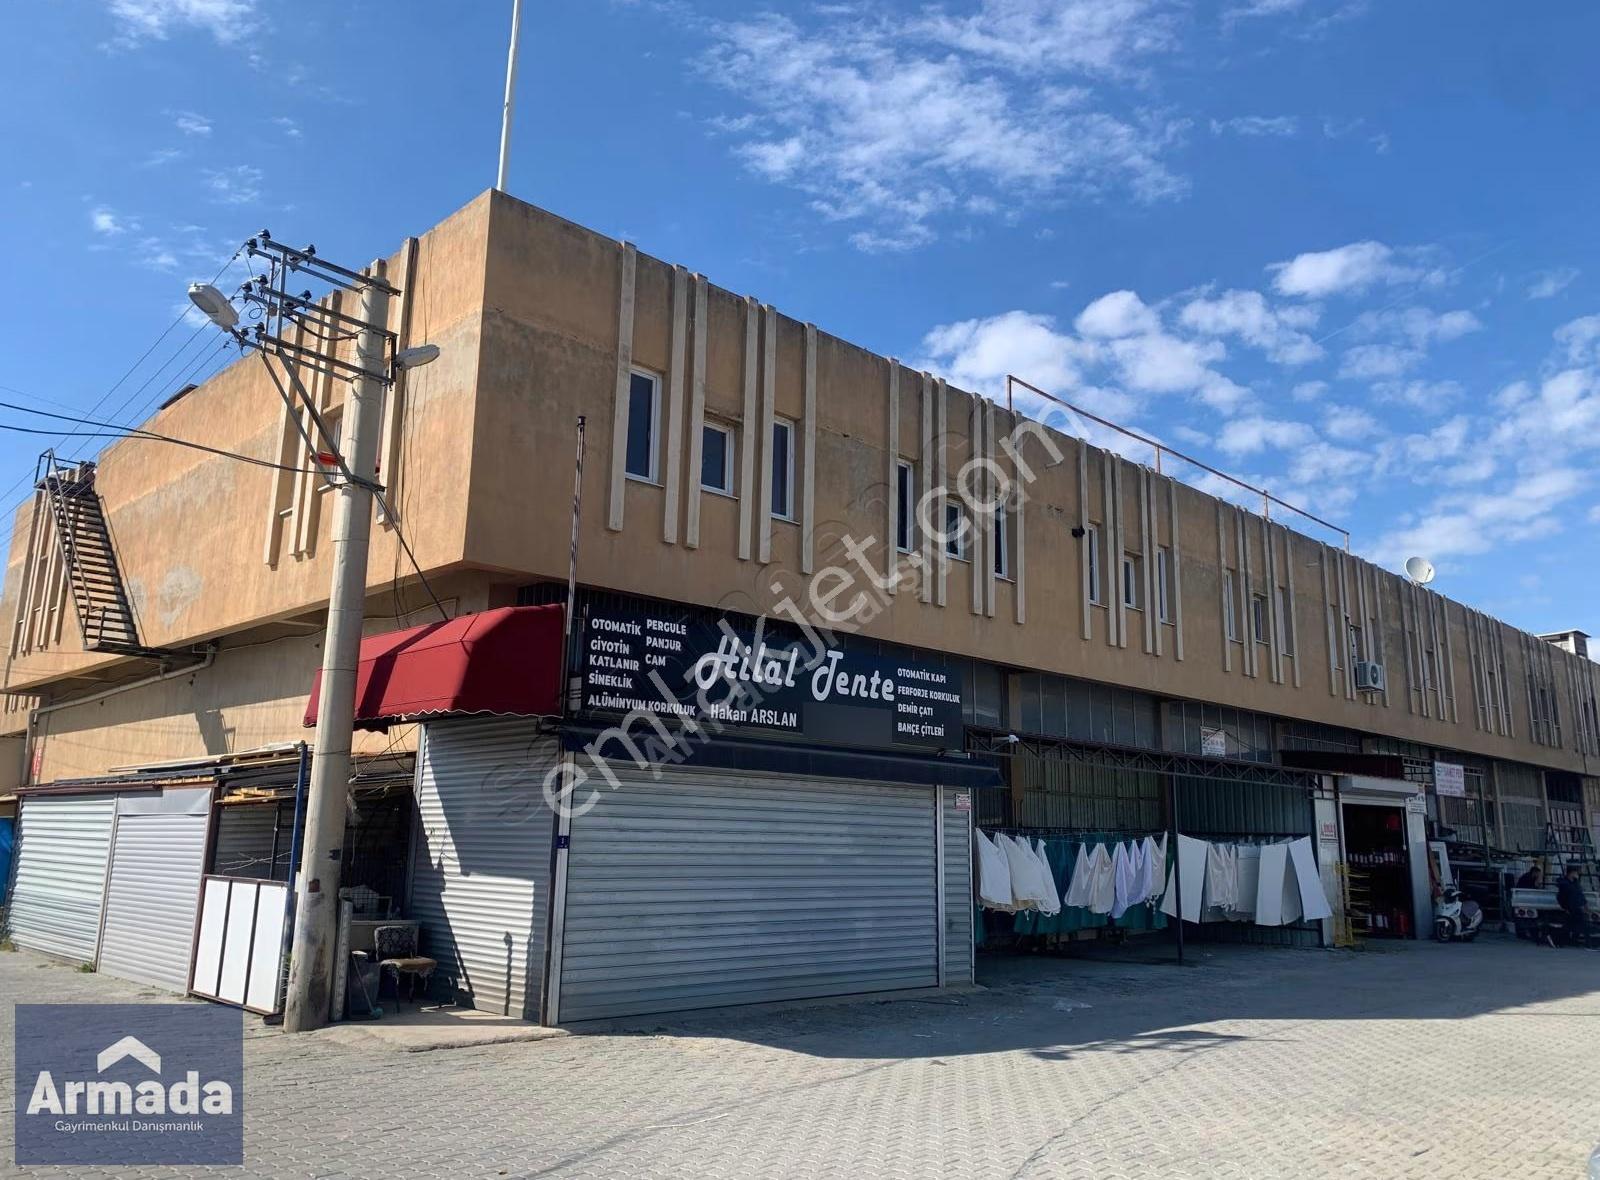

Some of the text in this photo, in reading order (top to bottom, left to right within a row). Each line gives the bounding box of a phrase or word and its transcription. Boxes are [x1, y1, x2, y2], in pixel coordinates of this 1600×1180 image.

[591, 618, 687, 636] OTOMATİK PERGULE
[590, 635, 681, 655] GİYOTİN PANJUR
[589, 653, 666, 671] KATLANIR CAM
[694, 635, 798, 690] Hilal
[588, 671, 633, 689] SİNEKLİK
[897, 667, 946, 684] OTOMATİK KAPI
[897, 685, 960, 704] FERFORJE KORKULUK
[588, 692, 696, 717] ALÜMİNYUM KORKULUK
[897, 702, 933, 717] DEMİR ÇATI
[710, 703, 797, 728] Hakan ARSLAN
[897, 722, 920, 736] BAHÇE
